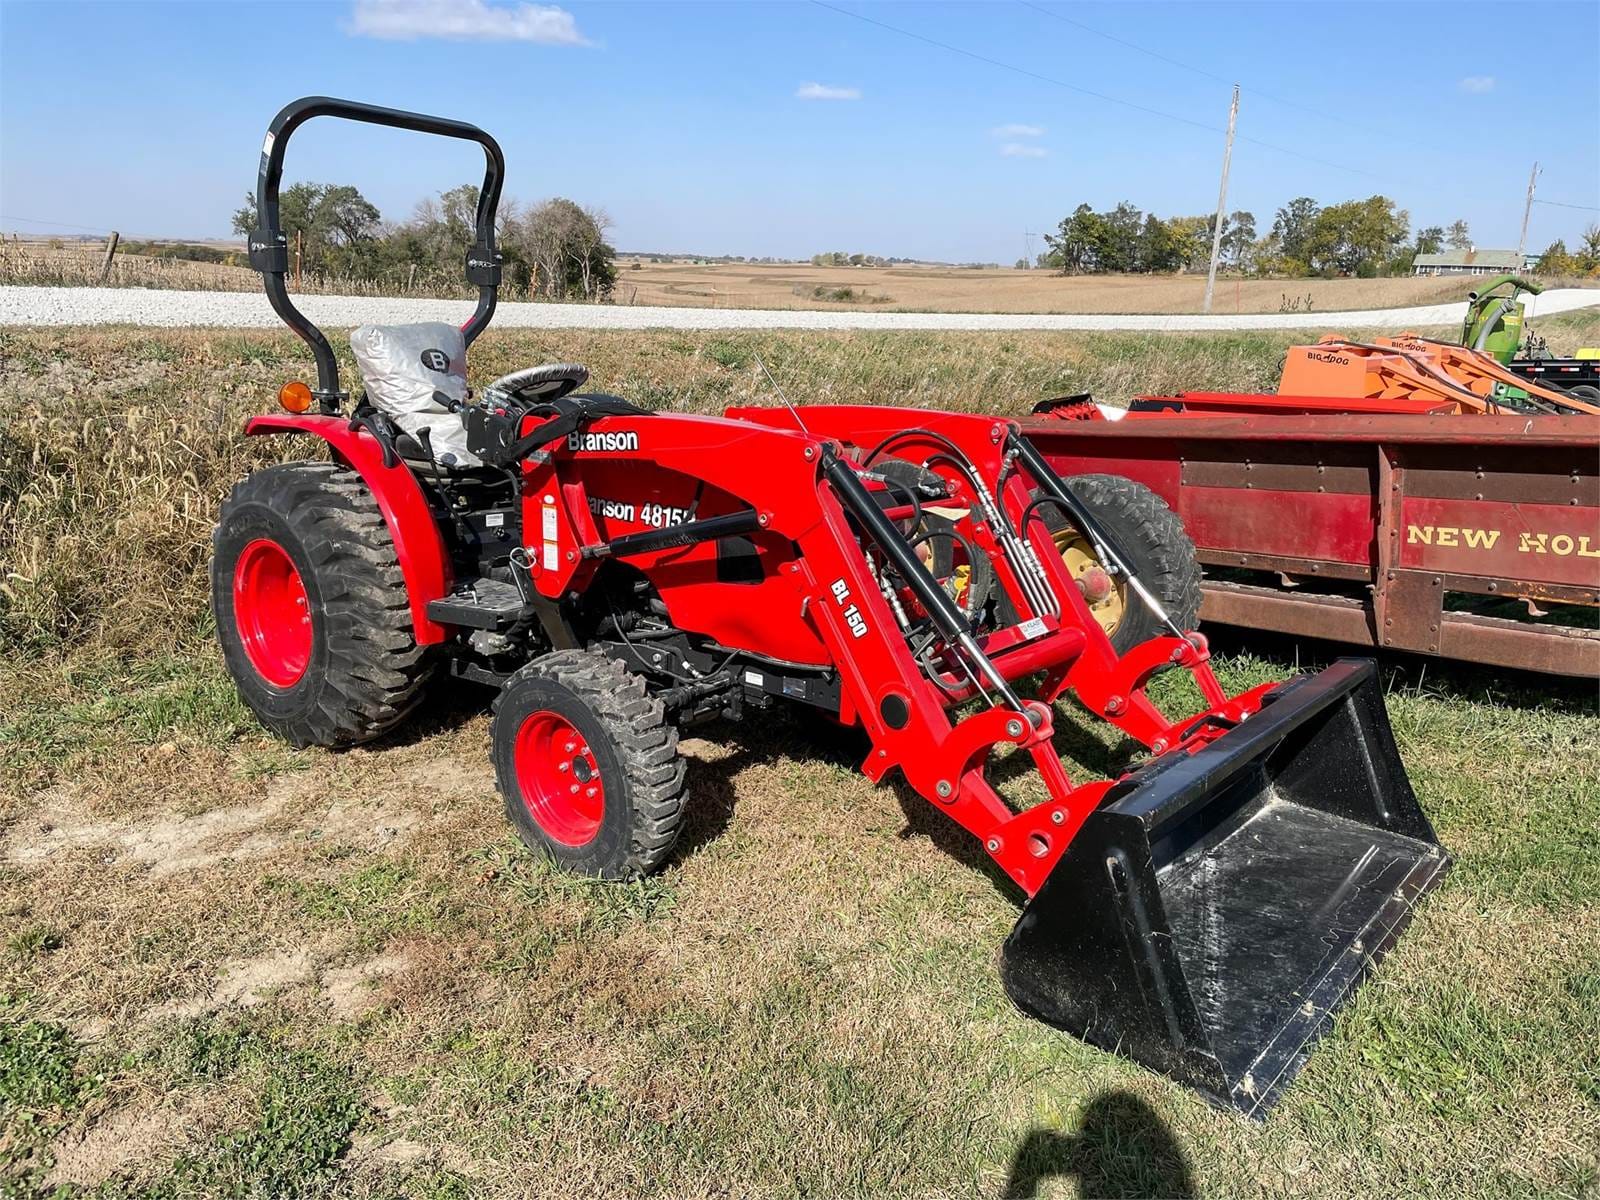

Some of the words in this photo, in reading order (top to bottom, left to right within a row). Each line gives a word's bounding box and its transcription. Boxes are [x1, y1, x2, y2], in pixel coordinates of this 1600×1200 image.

[1391, 341, 1404, 350] BIG
[1409, 345, 1427, 353] DOG
[429, 352, 446, 370] B
[1307, 352, 1322, 361] BIG
[1330, 356, 1350, 366] DOG
[567, 430, 639, 451] Branson
[588, 497, 635, 522] anson
[1407, 525, 1501, 549] NEW
[831, 579, 850, 606] BL
[844, 603, 868, 638] 150
